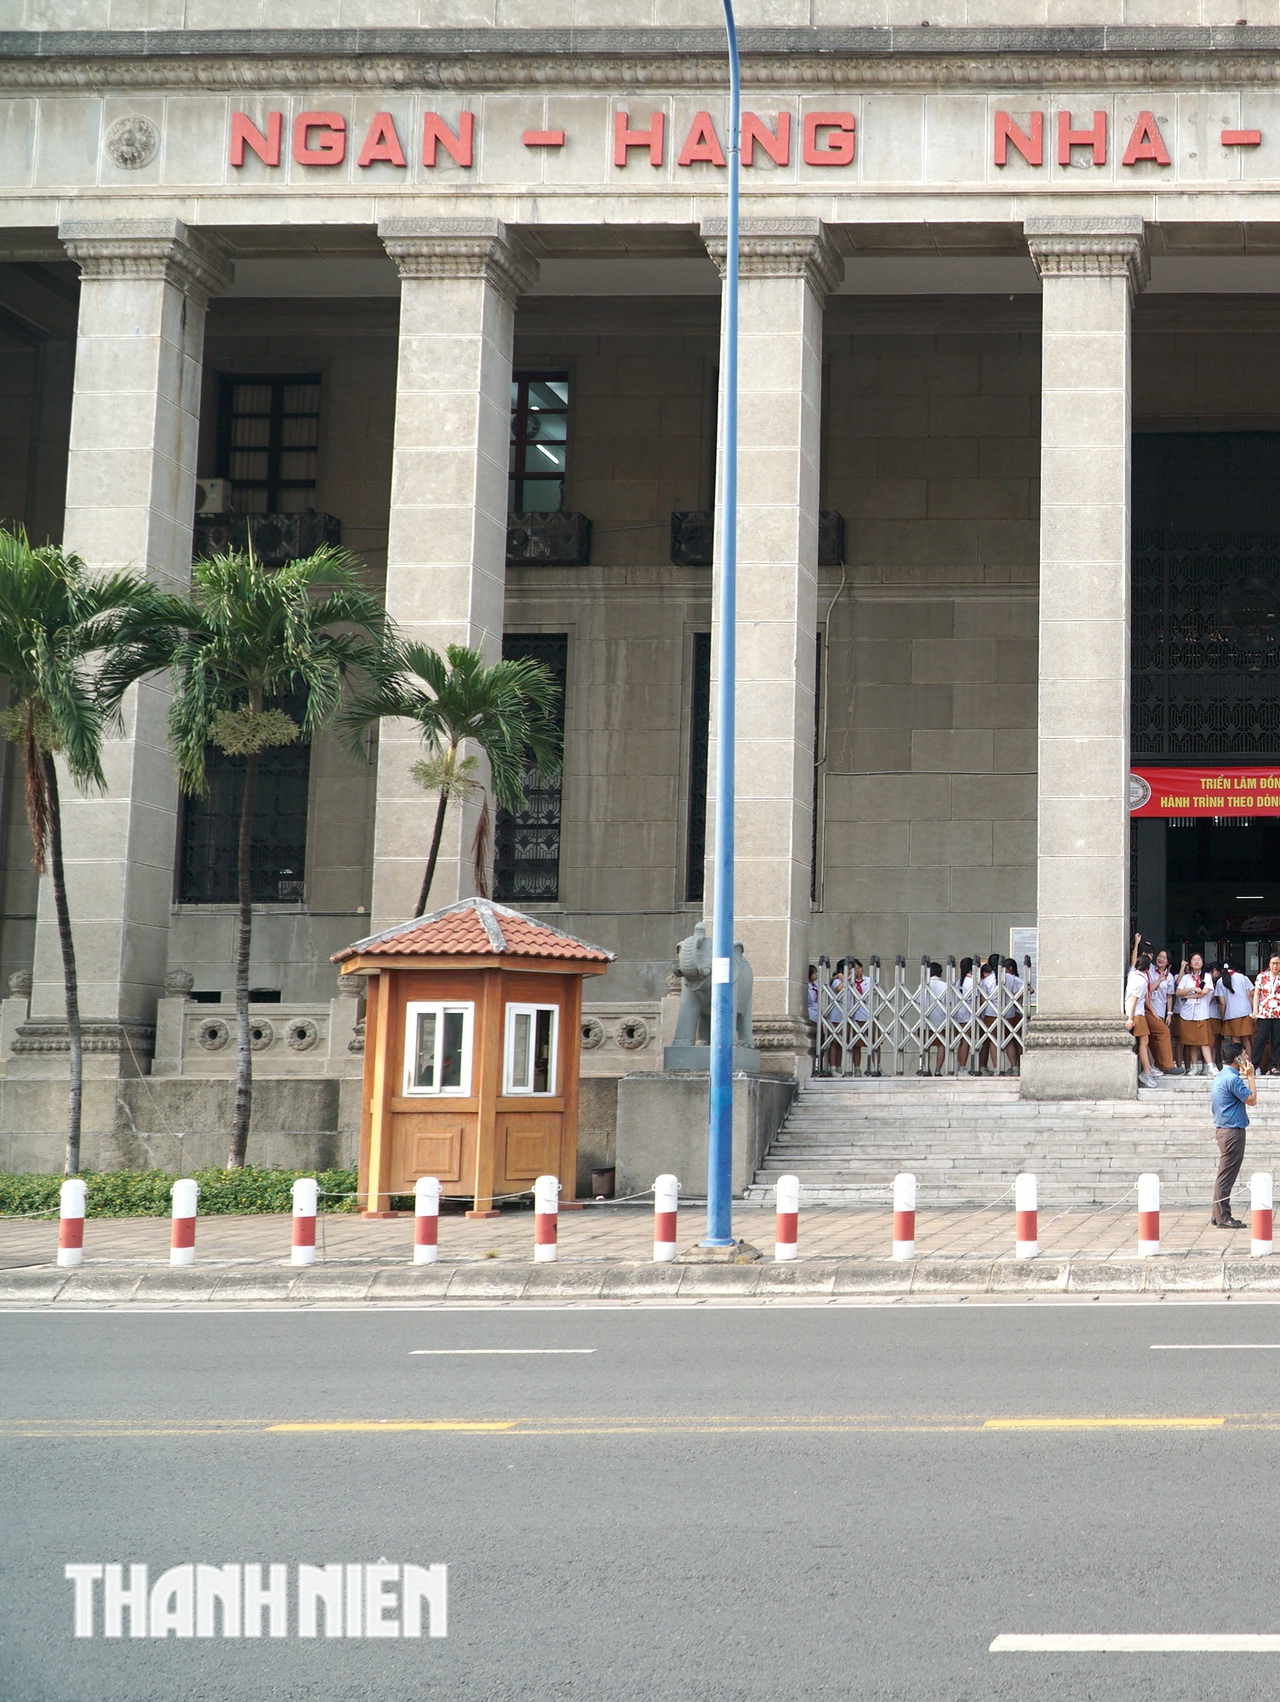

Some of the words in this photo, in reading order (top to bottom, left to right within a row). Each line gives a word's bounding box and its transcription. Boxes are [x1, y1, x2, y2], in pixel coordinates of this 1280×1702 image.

[231, 111, 475, 167] NGAN
[614, 111, 856, 167] HANG
[994, 110, 1171, 167] NHA
[1200, 773, 1231, 789] TRIỂN
[1234, 775, 1257, 789] LÃM
[1160, 794, 1190, 808] HÀNH
[1192, 794, 1224, 808] TRÌNH
[1227, 796, 1253, 808] THEO
